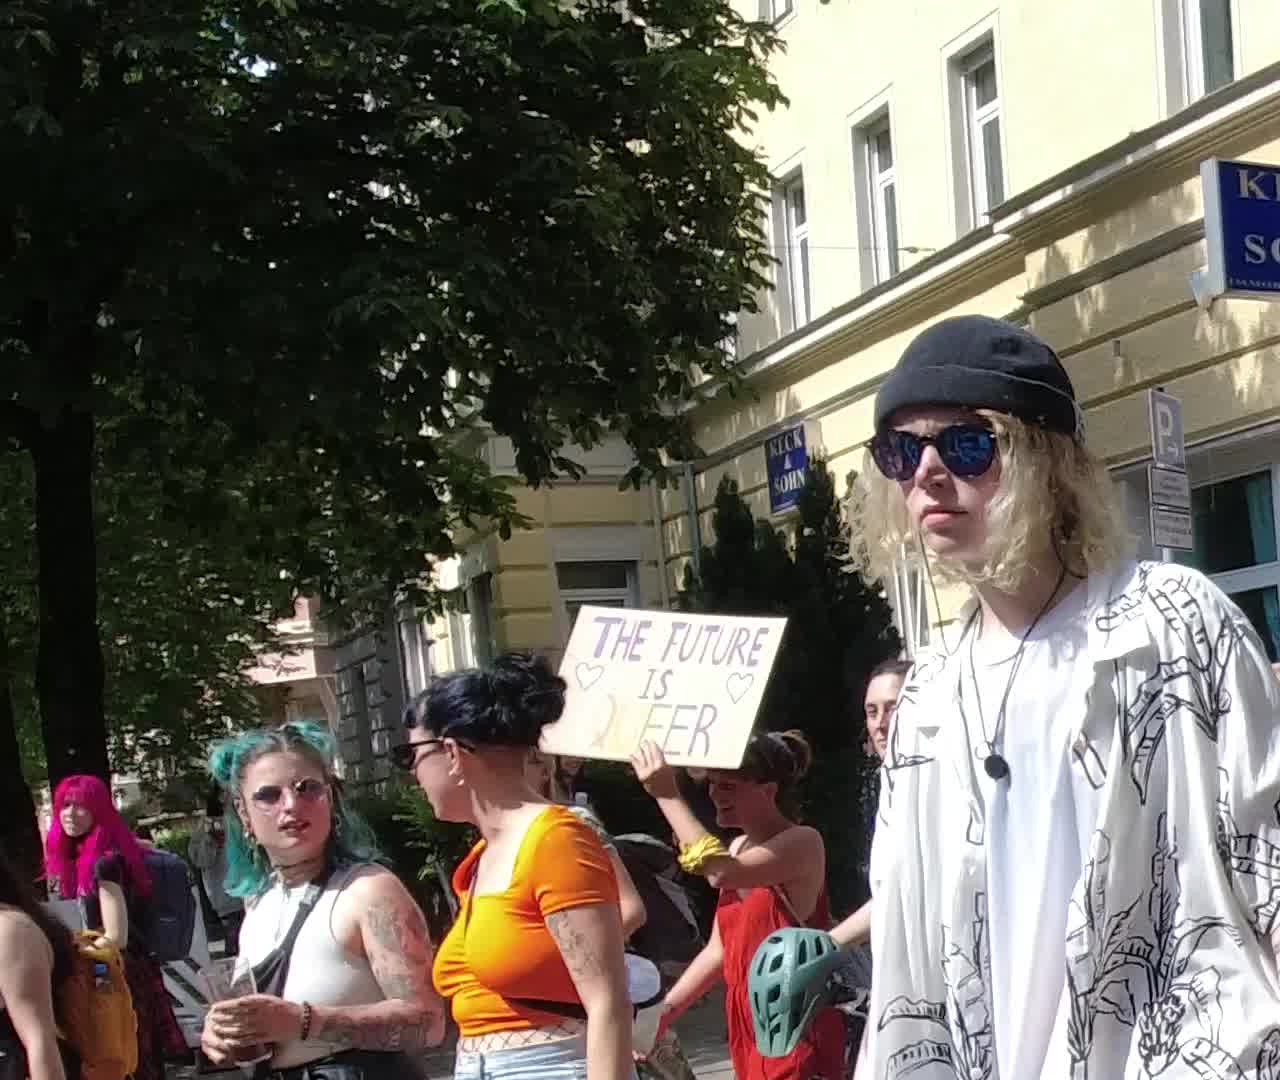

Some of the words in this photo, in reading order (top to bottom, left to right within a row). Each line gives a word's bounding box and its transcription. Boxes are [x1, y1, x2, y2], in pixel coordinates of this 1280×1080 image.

[593, 616, 652, 662] THE
[661, 621, 769, 668] FUTURE
[638, 668, 673, 700] IS
